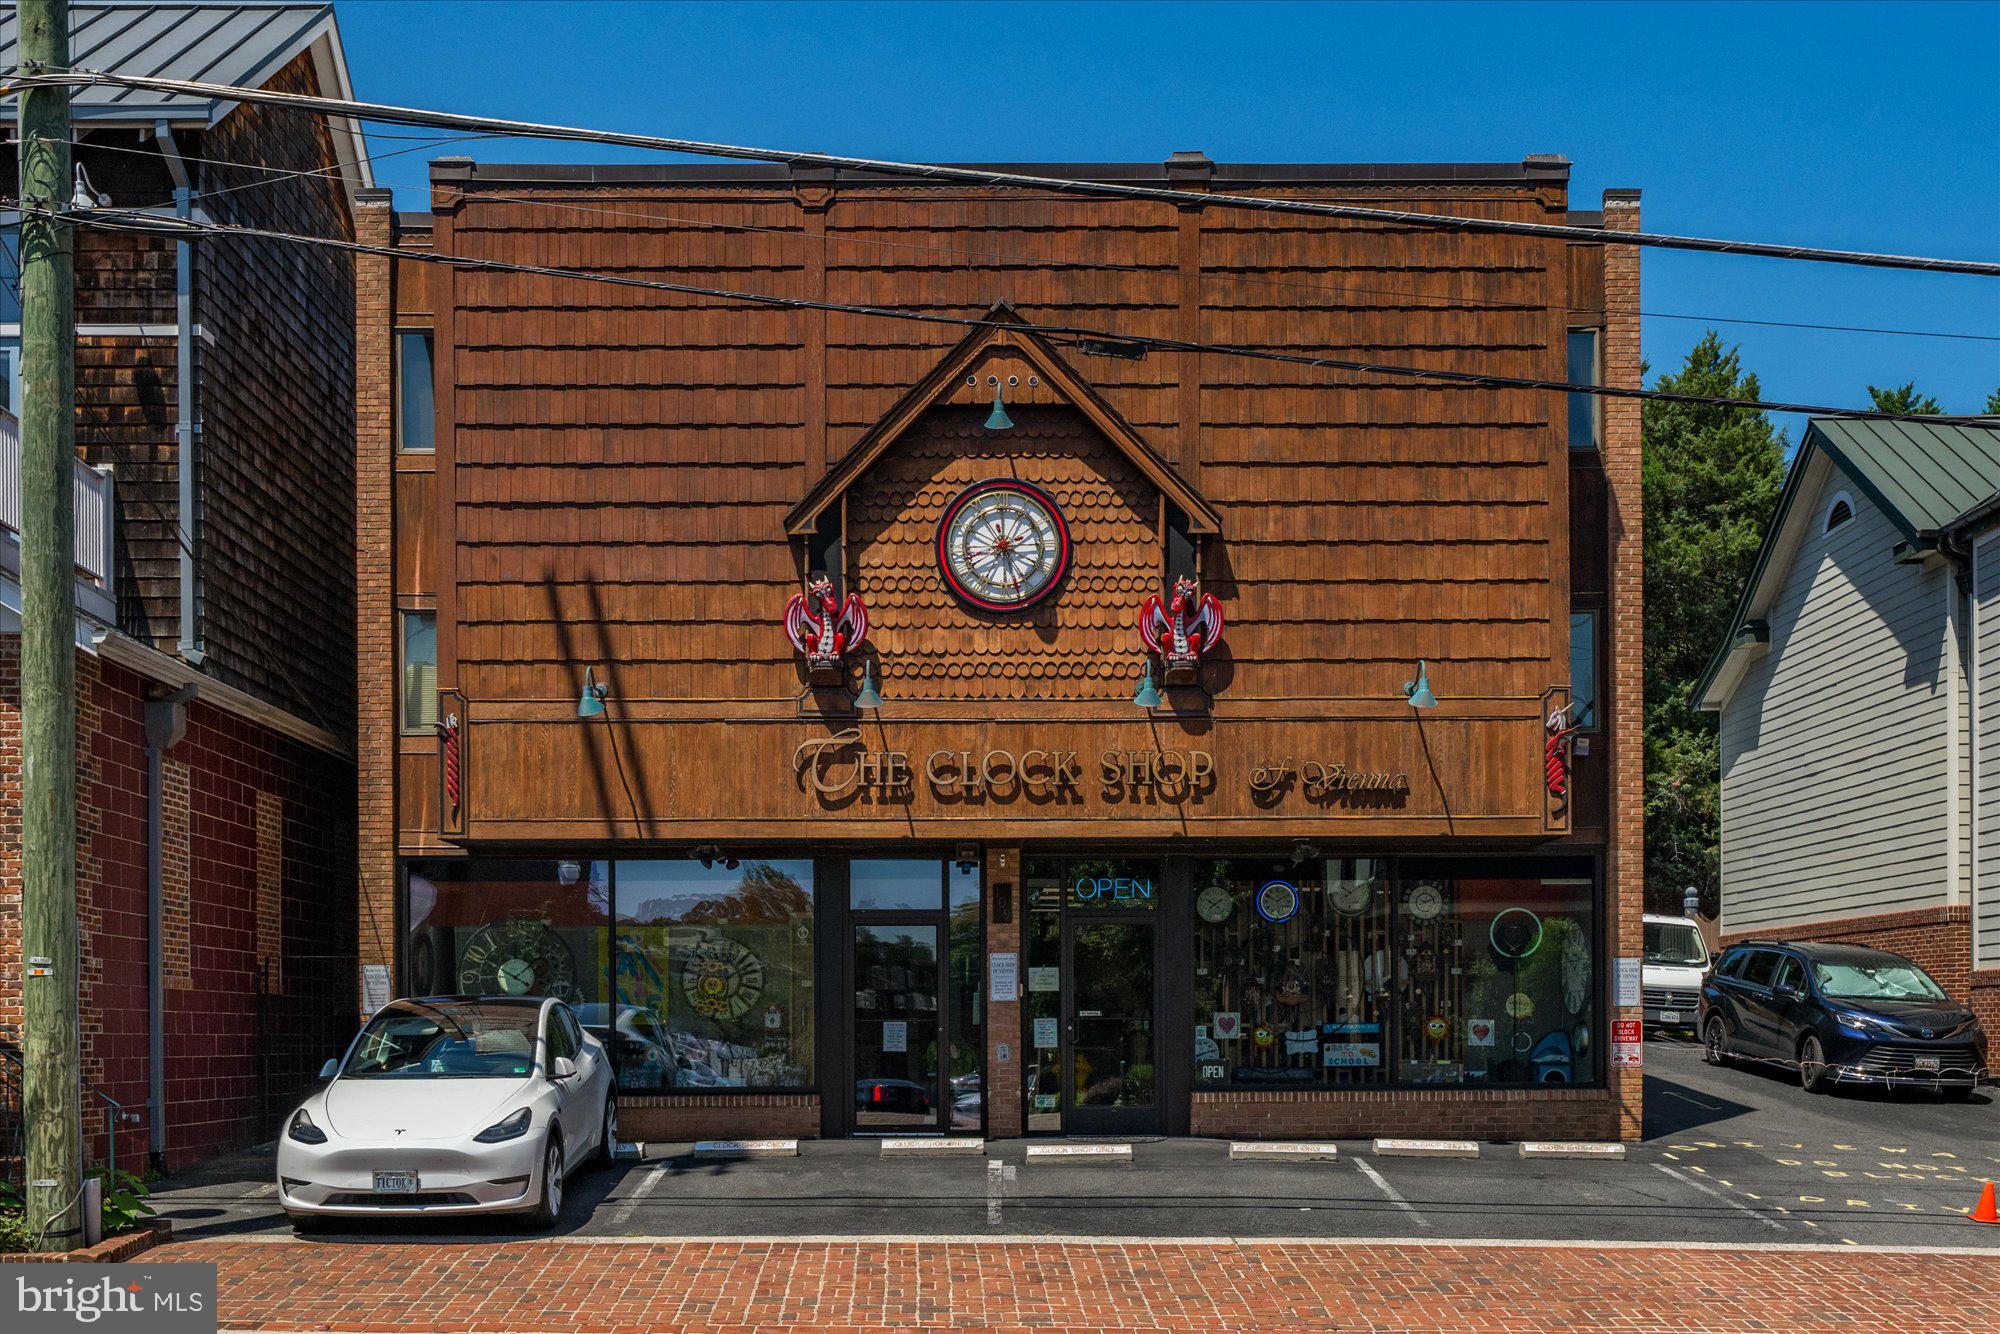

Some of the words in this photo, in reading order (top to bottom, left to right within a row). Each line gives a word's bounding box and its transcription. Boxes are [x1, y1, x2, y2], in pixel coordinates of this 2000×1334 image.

[926, 750, 1079, 786] CLOCK
[1098, 750, 1214, 786] SHOP
[1301, 760, 1407, 790] Vienna
[1076, 878, 1151, 899] OPEN
[1202, 1065, 1224, 1078] OPEN
[1776, 1158, 1838, 1167] DO
[1878, 1162, 1968, 1173] NOT
